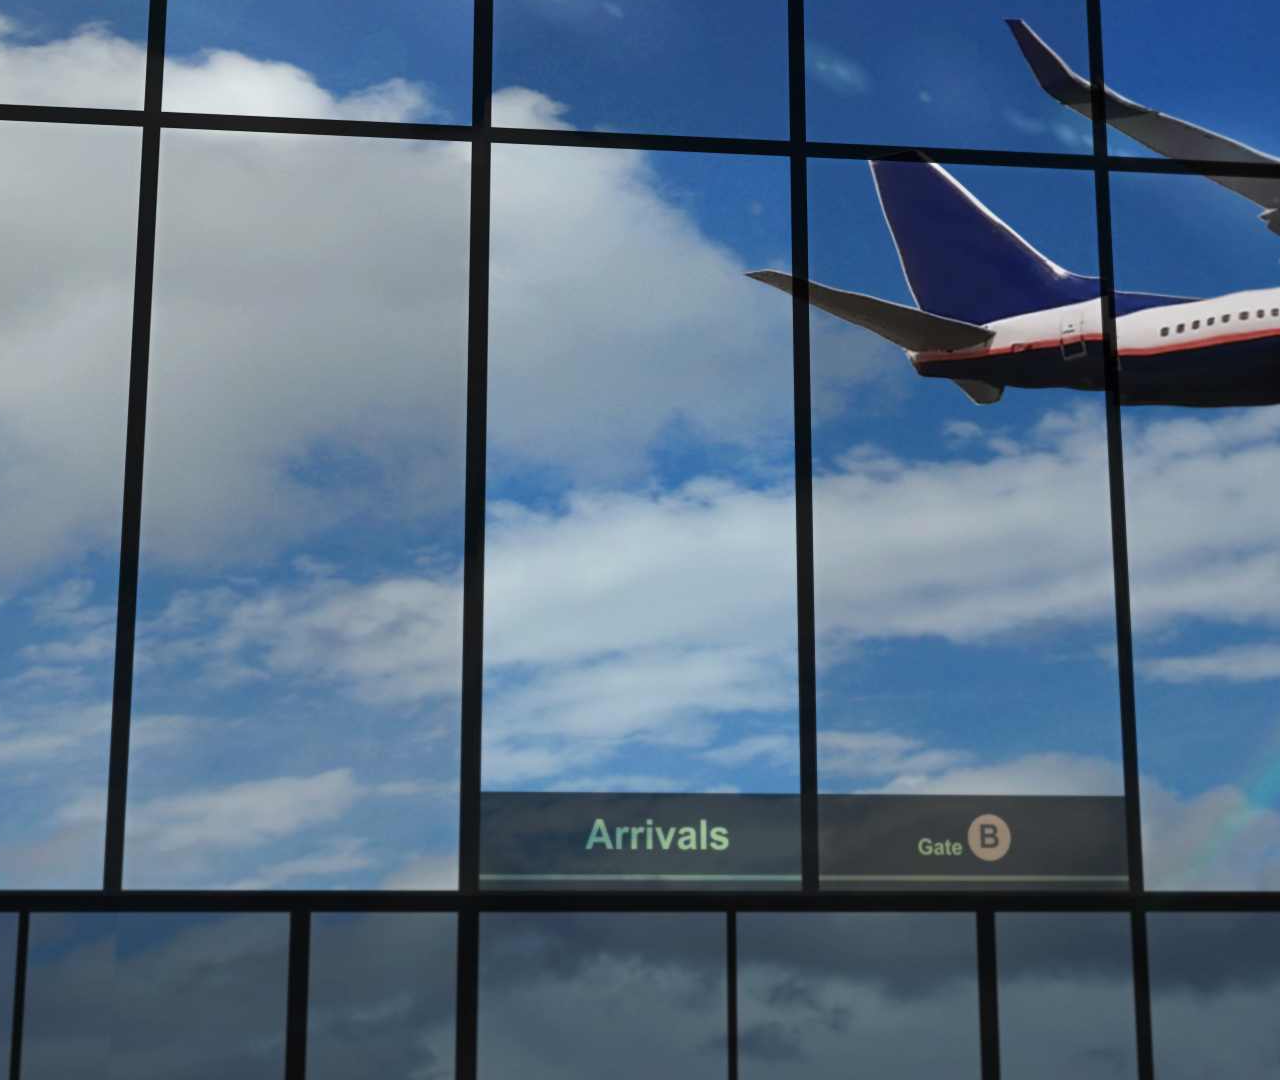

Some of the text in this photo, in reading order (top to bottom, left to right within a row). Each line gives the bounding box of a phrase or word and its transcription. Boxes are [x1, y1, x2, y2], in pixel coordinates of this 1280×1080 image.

[585, 818, 729, 851] Arrivals
[918, 824, 999, 857] Gate B
